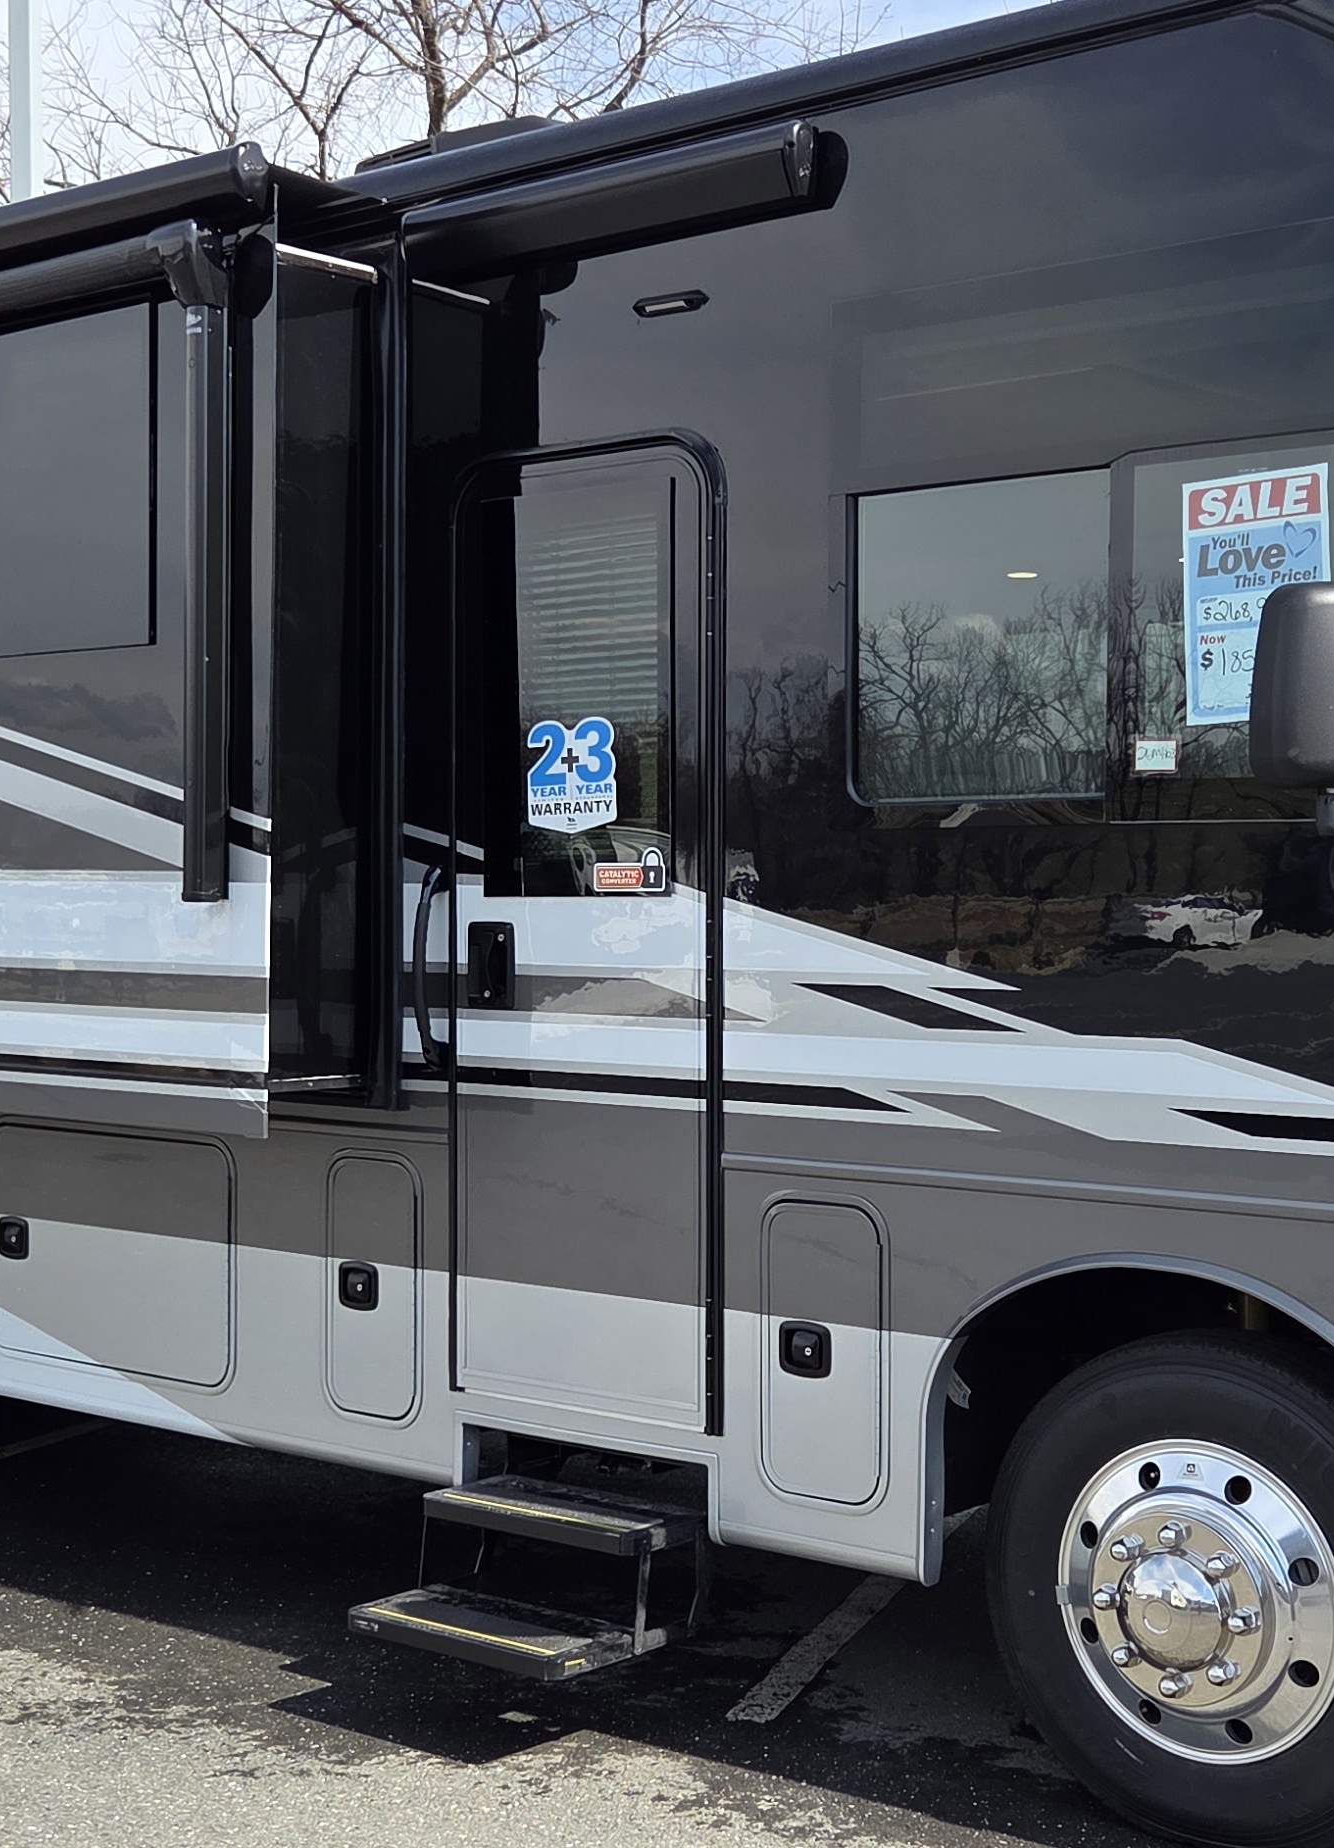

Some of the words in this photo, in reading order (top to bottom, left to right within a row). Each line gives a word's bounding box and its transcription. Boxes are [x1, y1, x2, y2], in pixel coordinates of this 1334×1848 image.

[1198, 476, 1312, 526] SALE
[1211, 532, 1250, 551] You'll
[1197, 543, 1287, 578] Love
[1234, 573, 1266, 590] This
[1270, 566, 1318, 584] Price!
[1200, 635, 1226, 645] Now
[531, 785, 566, 798] YEAR
[576, 783, 613, 795] YEAR
[531, 800, 613, 816] WARRANTY
[599, 870, 639, 878] CATALYTIC
